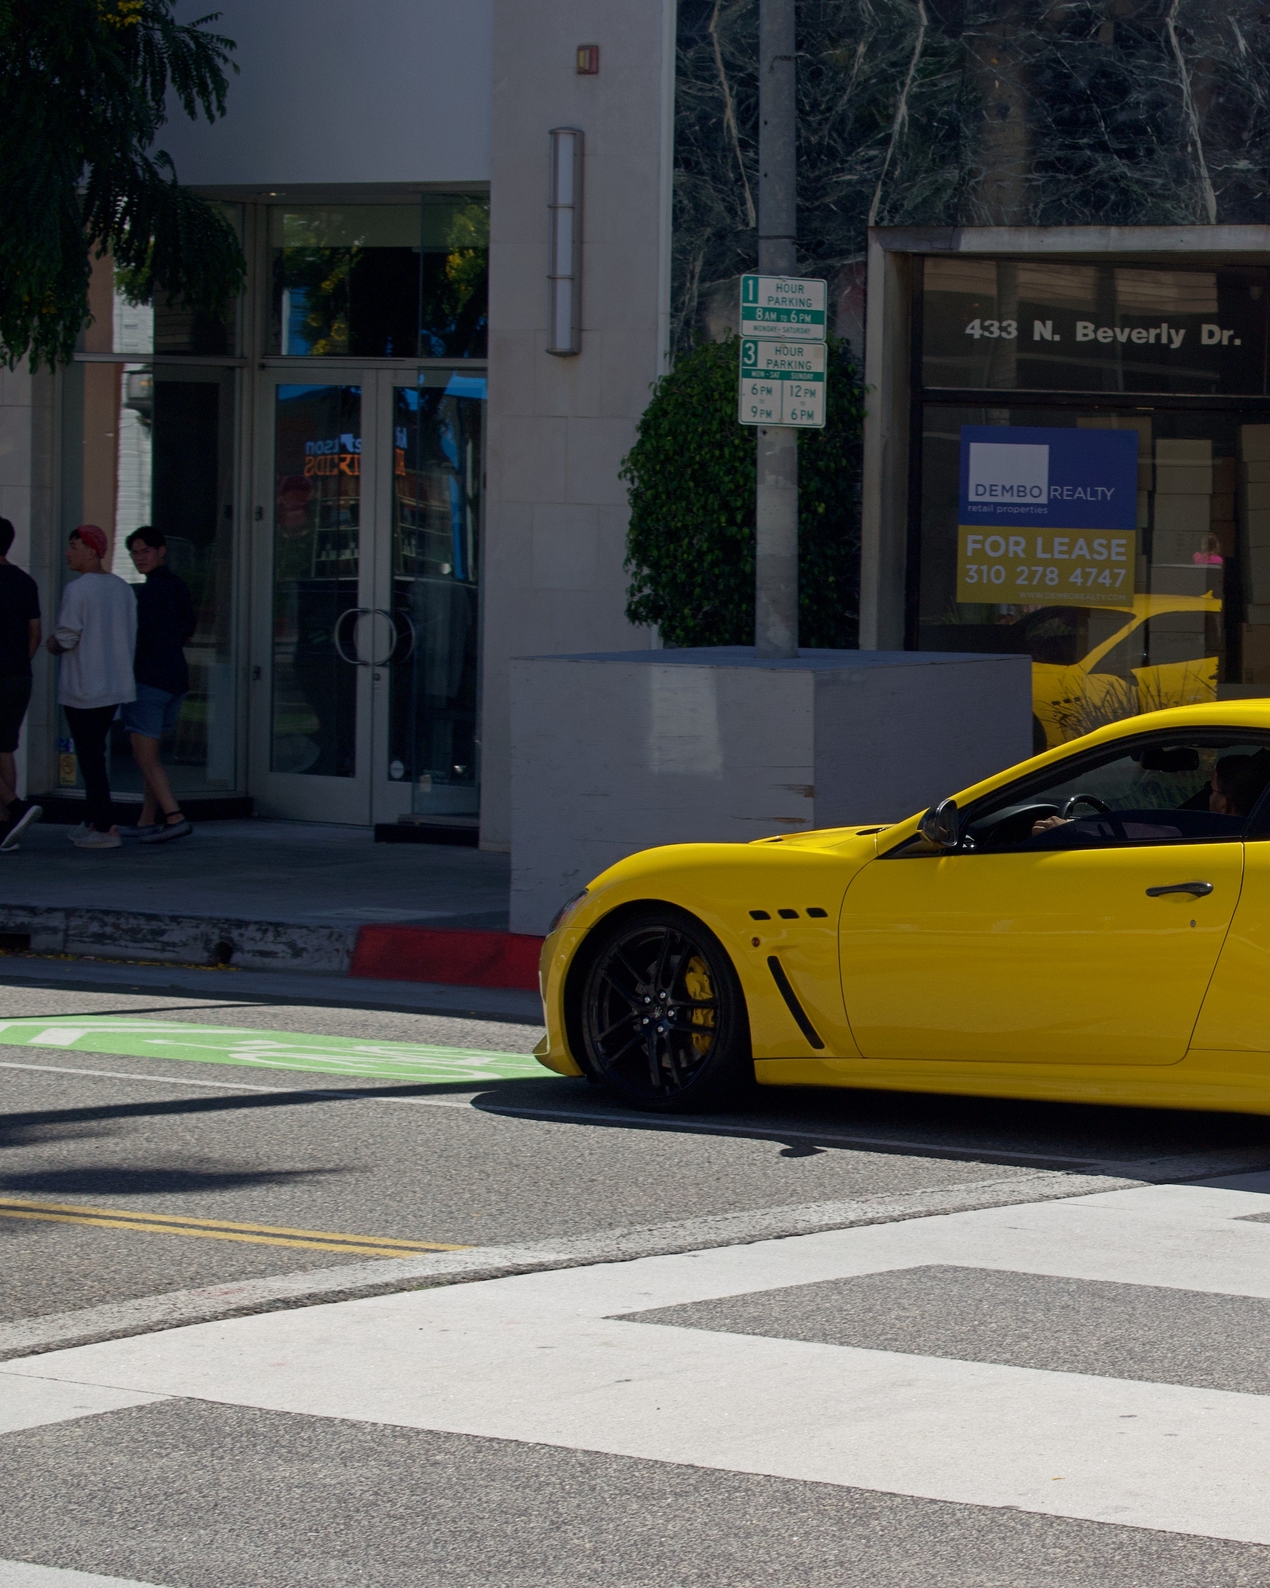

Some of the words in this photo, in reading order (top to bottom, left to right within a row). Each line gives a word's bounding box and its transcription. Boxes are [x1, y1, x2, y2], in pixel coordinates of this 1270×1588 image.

[747, 279, 754, 301] 1
[776, 283, 805, 294] HOUR
[767, 296, 812, 308] PARKING
[753, 324, 777, 332] MONDAY
[782, 326, 812, 335] SATURDAY
[965, 318, 1018, 340] 433
[1033, 320, 1061, 342] N.
[1075, 321, 1187, 349] Beverly
[1201, 324, 1242, 346] Dr.
[743, 342, 756, 365] 3
[775, 346, 804, 357] HOUR
[766, 359, 812, 371] PARKING
[790, 372, 815, 380] SUNDAY
[975, 483, 1043, 499] DEMBO
[1051, 485, 1116, 501] REALTY
[967, 504, 994, 513] retail
[996, 504, 1049, 515] properties
[966, 534, 1026, 558] FOR
[1036, 536, 1127, 561] LEASE
[965, 564, 1006, 584] 310
[1015, 566, 1059, 586] 278
[1068, 567, 1127, 588] 4747
